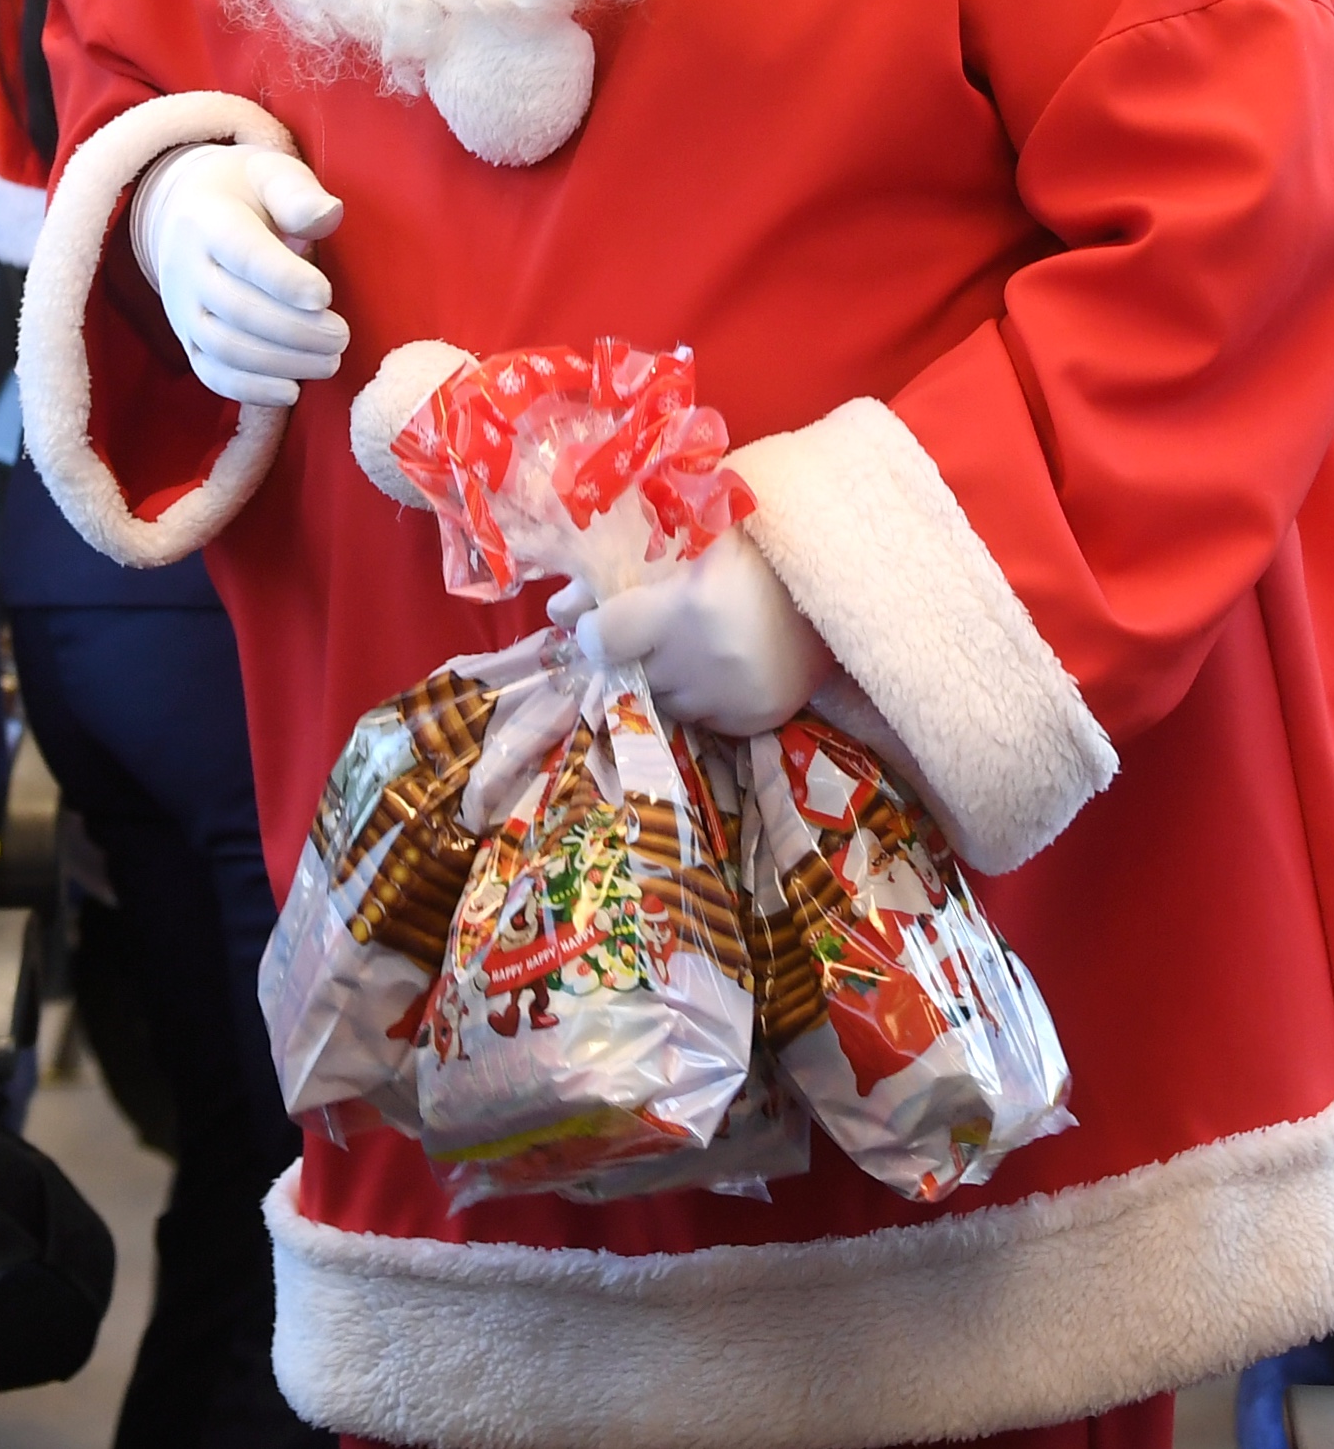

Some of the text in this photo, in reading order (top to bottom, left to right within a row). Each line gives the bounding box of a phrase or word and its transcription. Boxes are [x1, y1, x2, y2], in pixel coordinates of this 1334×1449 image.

[491, 925, 595, 983] HAPPY HAPPY HAPPY
